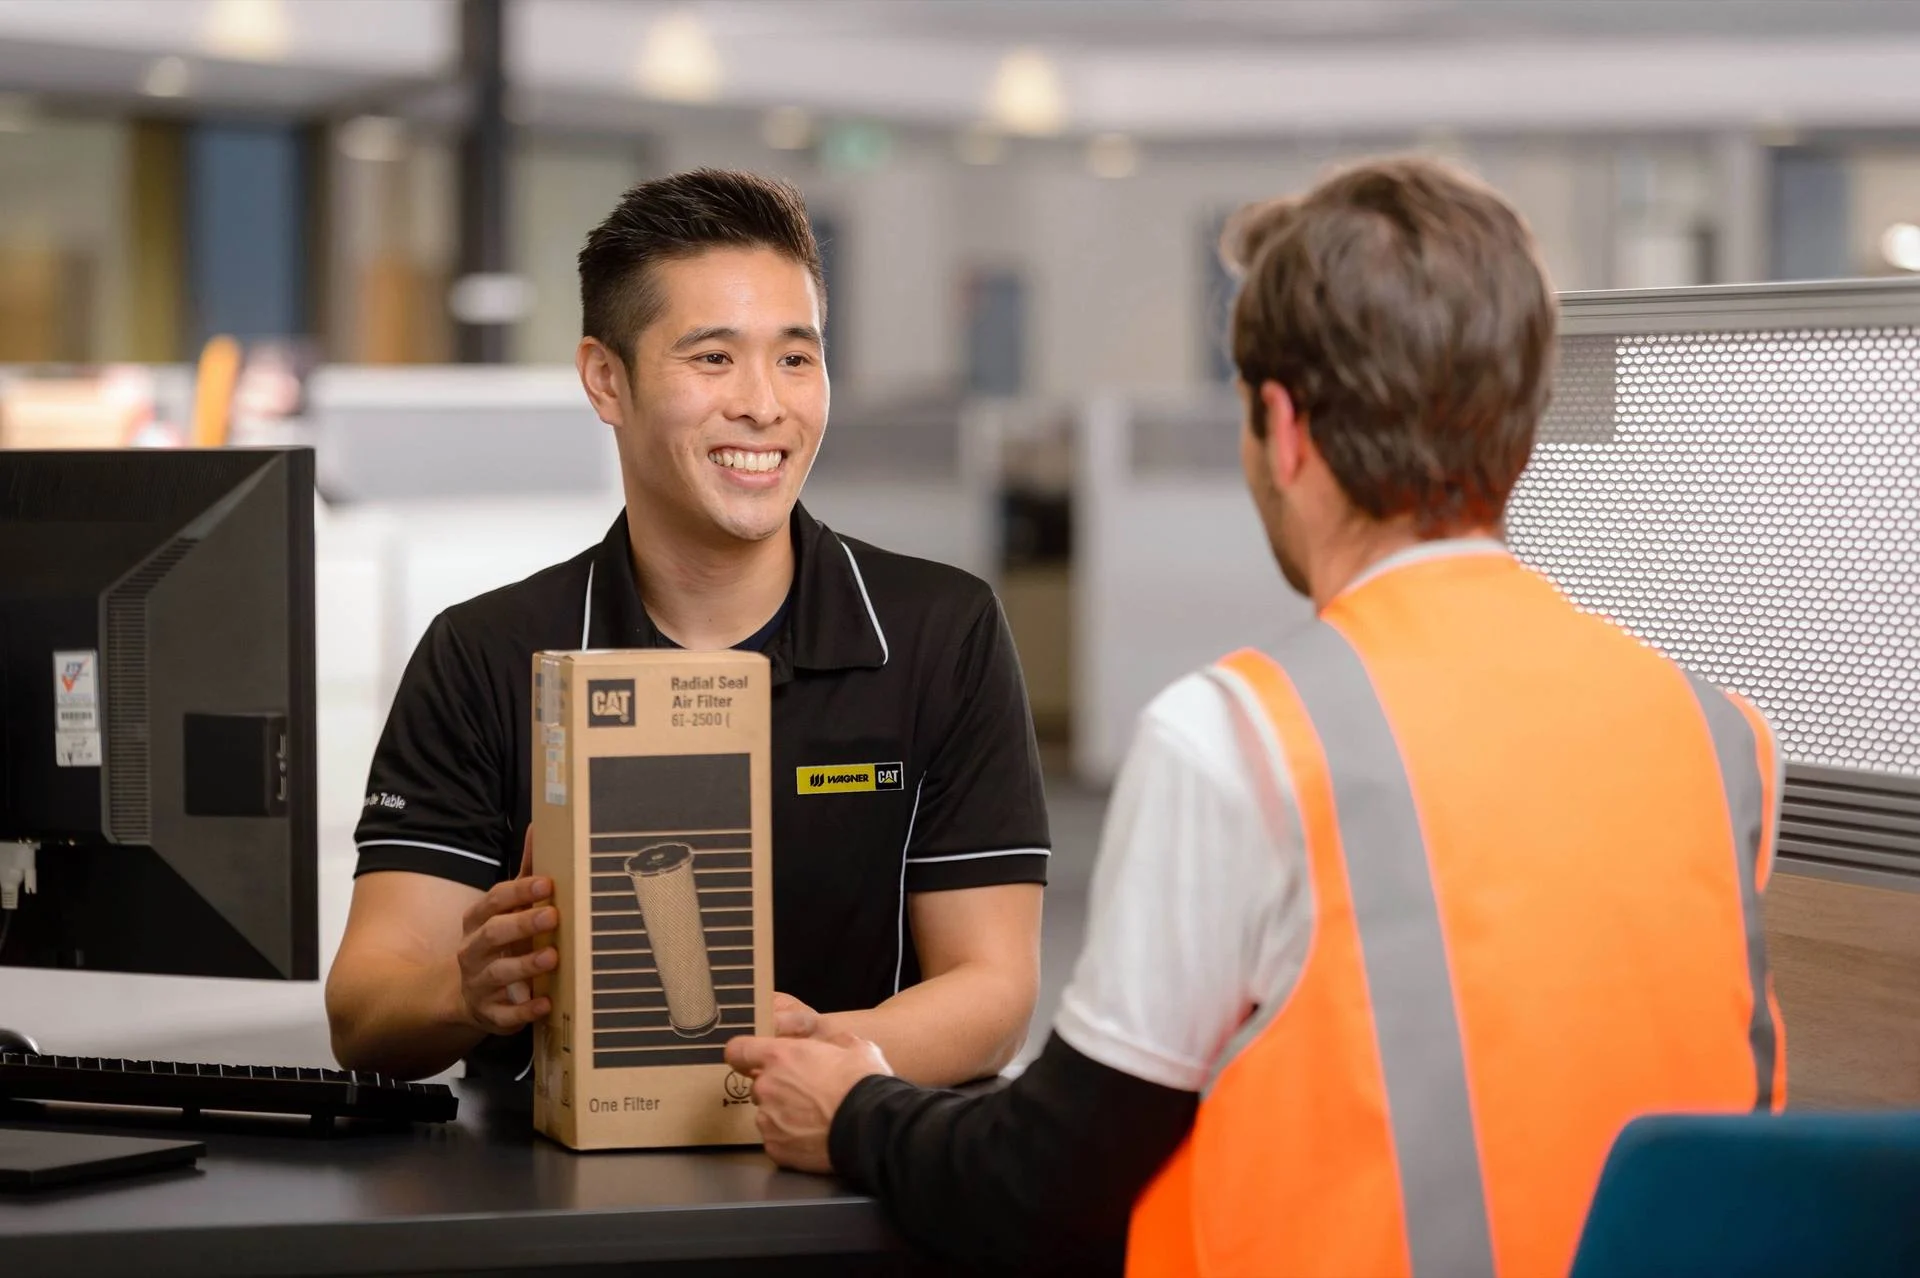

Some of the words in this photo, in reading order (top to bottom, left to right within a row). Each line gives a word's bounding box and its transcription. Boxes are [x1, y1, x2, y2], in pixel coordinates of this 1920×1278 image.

[671, 676, 714, 691] Radial
[718, 675, 748, 690] Seal
[591, 690, 631, 717] CAT
[672, 695, 693, 709] Air
[697, 694, 733, 708] Filter
[827, 773, 869, 784] WAGNER
[878, 770, 899, 784] CAT
[380, 792, 406, 809] Table
[589, 1098, 618, 1113] One
[623, 1097, 660, 1112] Filter
